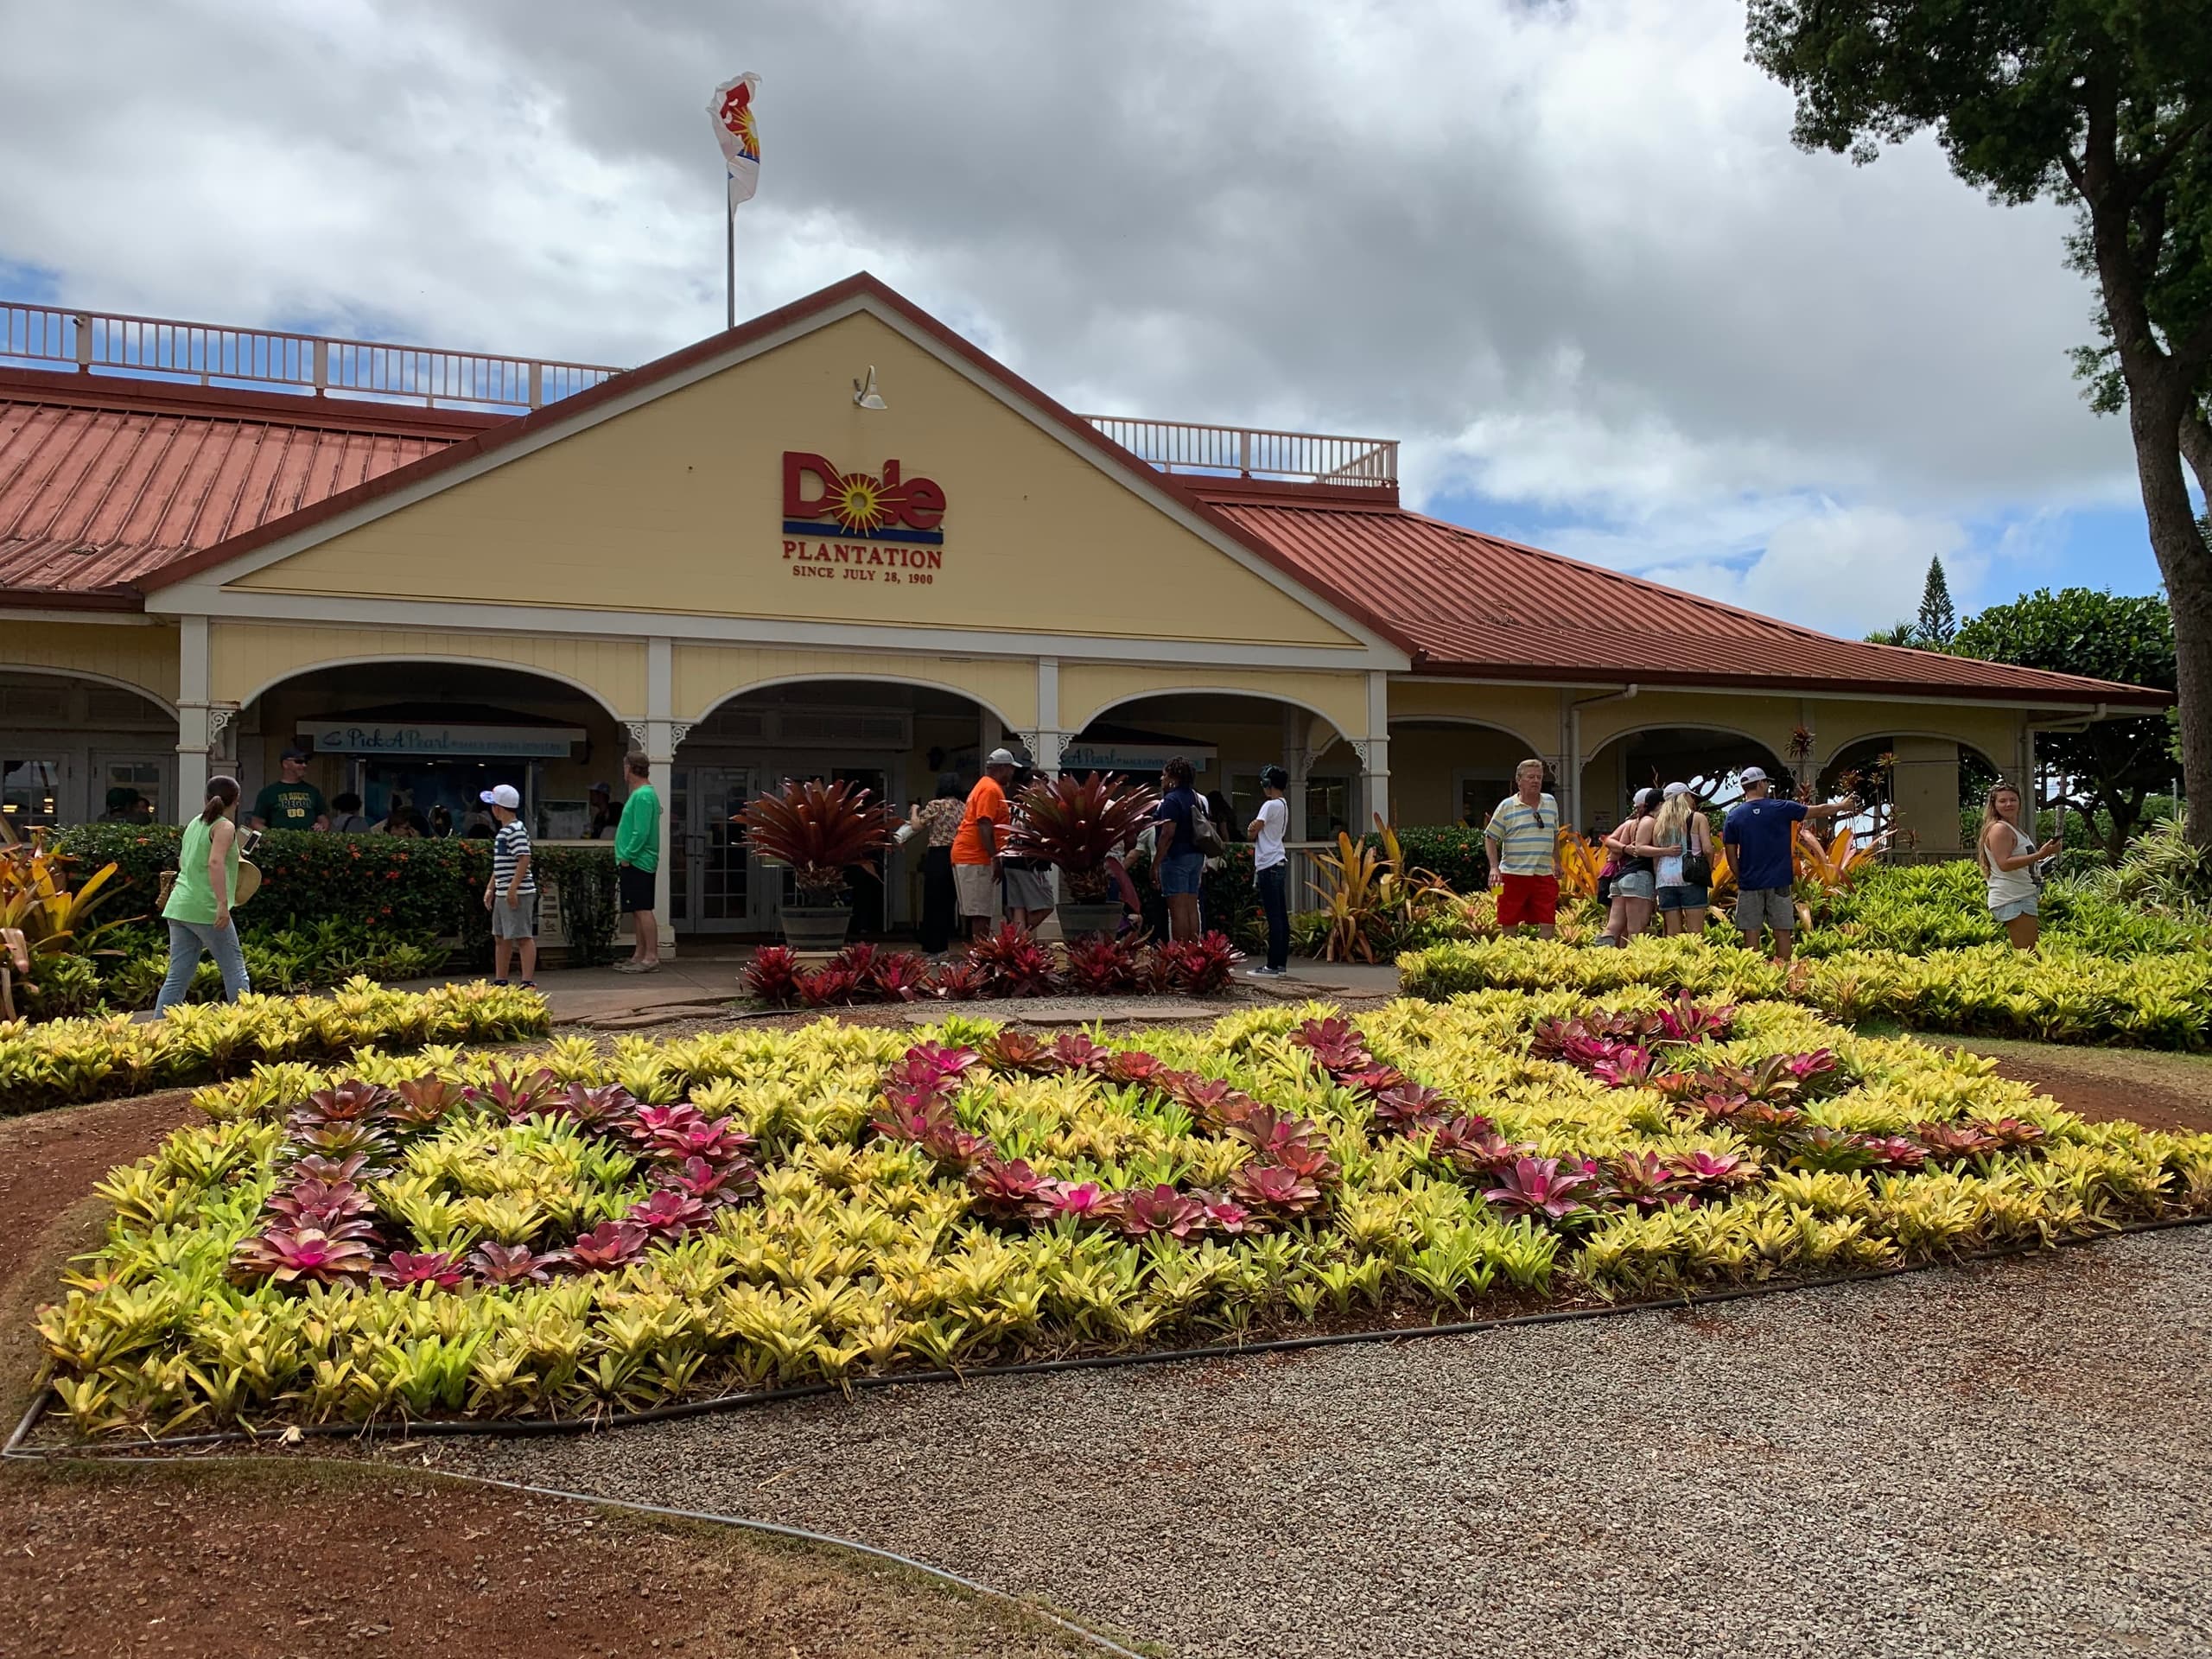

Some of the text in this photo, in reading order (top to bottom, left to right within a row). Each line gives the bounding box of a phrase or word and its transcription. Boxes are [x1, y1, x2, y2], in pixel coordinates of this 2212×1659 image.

[783, 451, 947, 530] Dole
[782, 540, 943, 569] PLANTATION
[792, 565, 933, 585] SINCE JULY 28, 1900
[347, 728, 384, 748] Pick
[385, 729, 404, 749] A
[406, 729, 450, 750] Pearl
